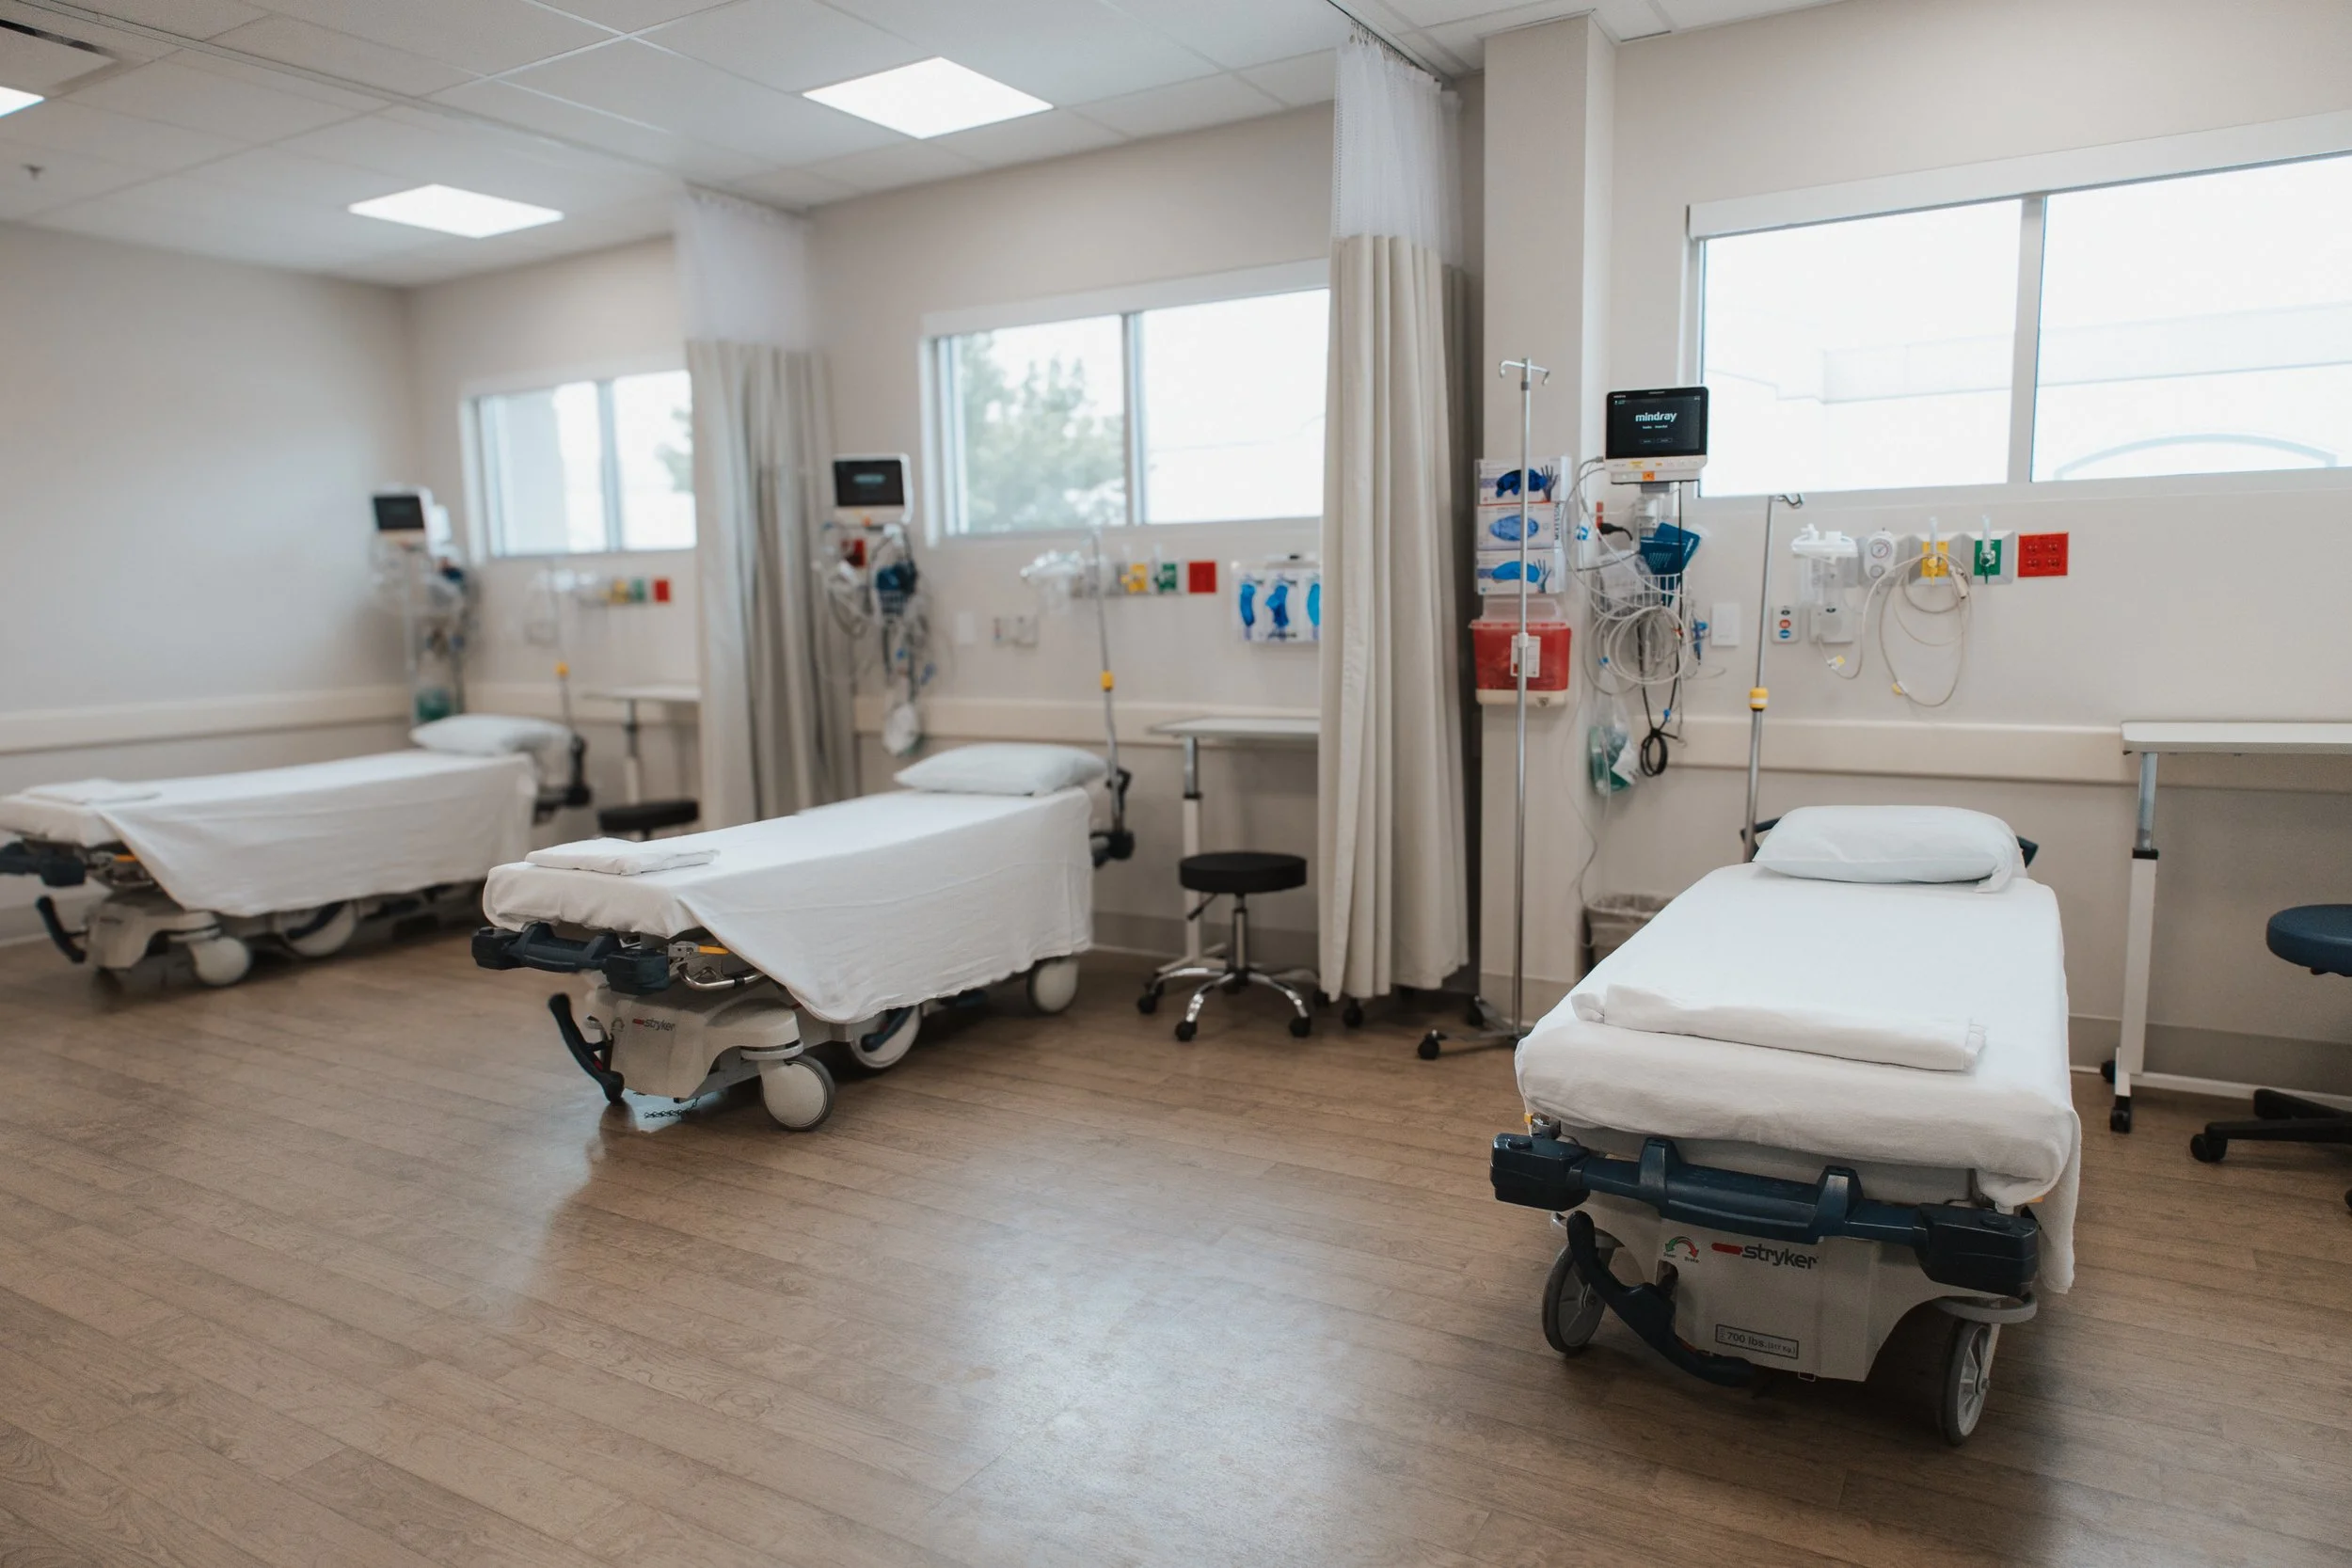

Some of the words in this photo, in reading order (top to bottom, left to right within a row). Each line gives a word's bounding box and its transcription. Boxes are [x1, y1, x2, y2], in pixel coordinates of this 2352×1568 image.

[1635, 411, 1677, 422] mindray
[644, 1019, 675, 1032] stryker
[1742, 1243, 1818, 1270] stryker
[1726, 1331, 1746, 1343] 700
[1748, 1335, 1767, 1349] lbs.
